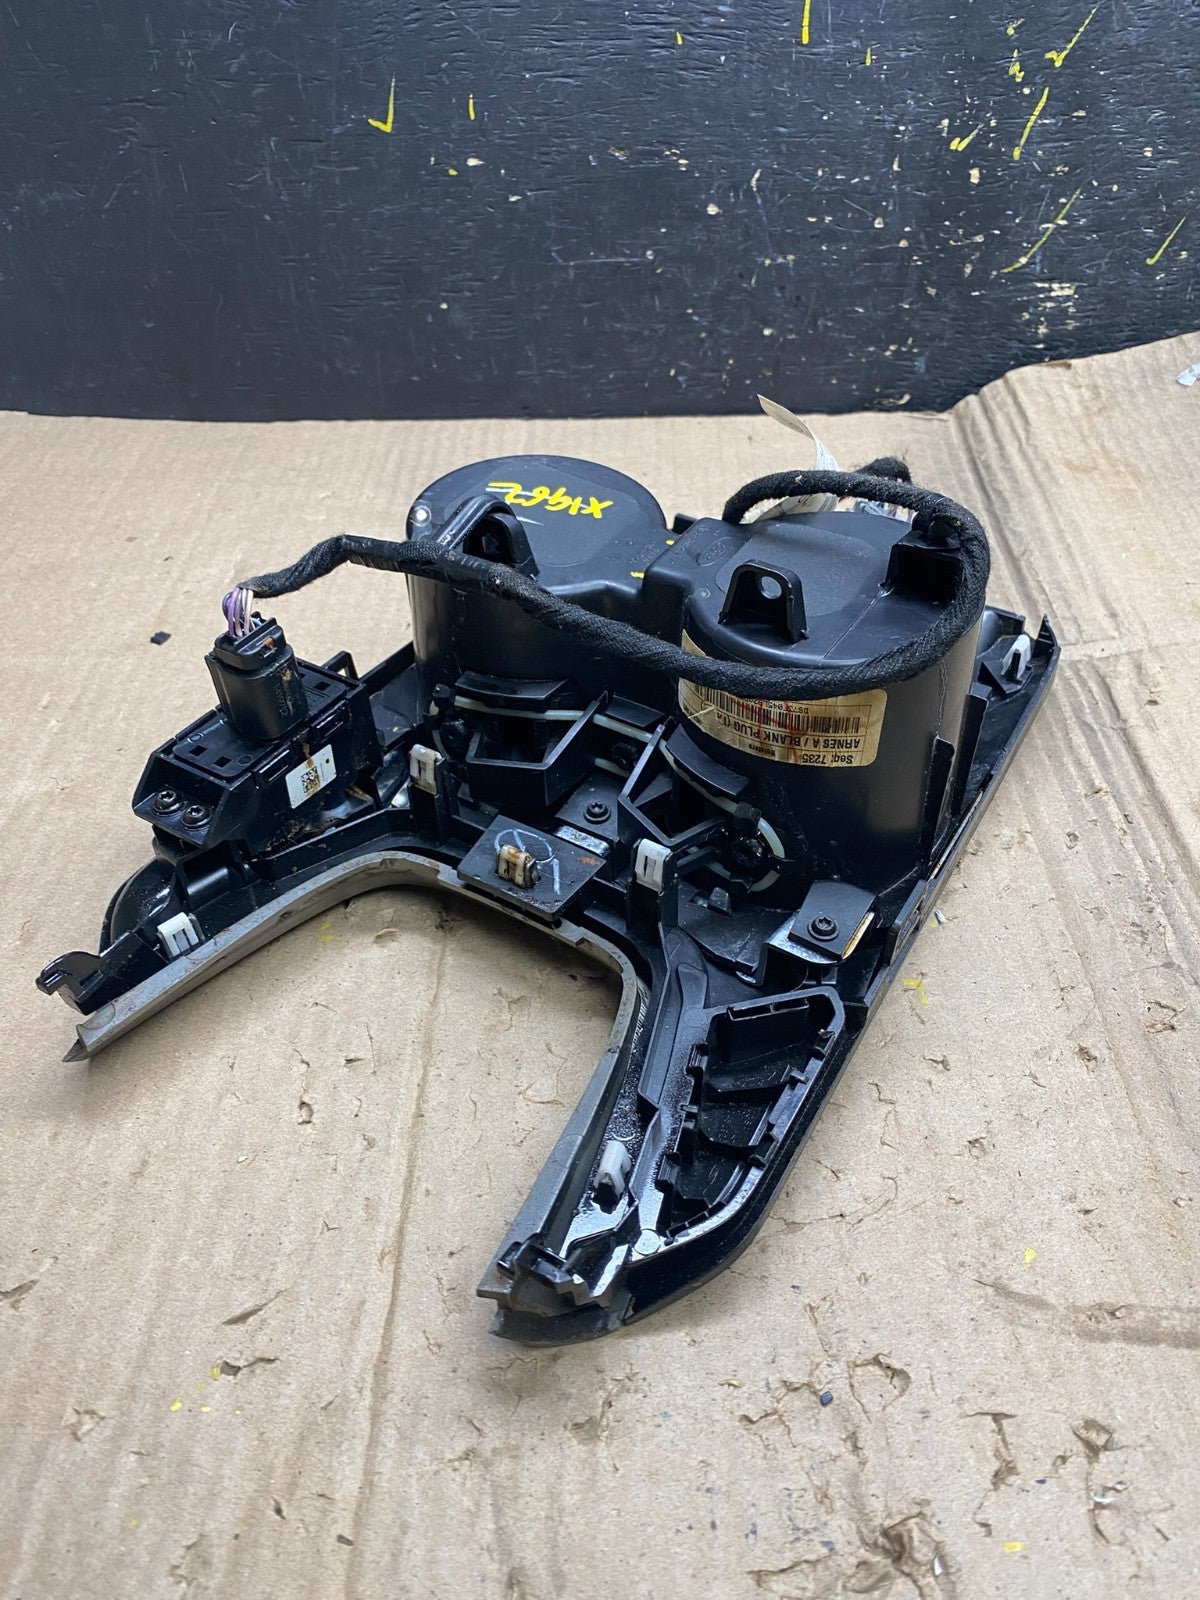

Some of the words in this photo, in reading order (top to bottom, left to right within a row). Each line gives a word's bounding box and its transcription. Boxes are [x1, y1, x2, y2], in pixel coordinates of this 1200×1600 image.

[734, 721, 760, 738] PLUG
[764, 730, 801, 746] BLANK
[812, 738, 820, 748] A
[823, 738, 860, 749] ARNES
[802, 752, 826, 765] 7235
[830, 752, 854, 765] Seq:
